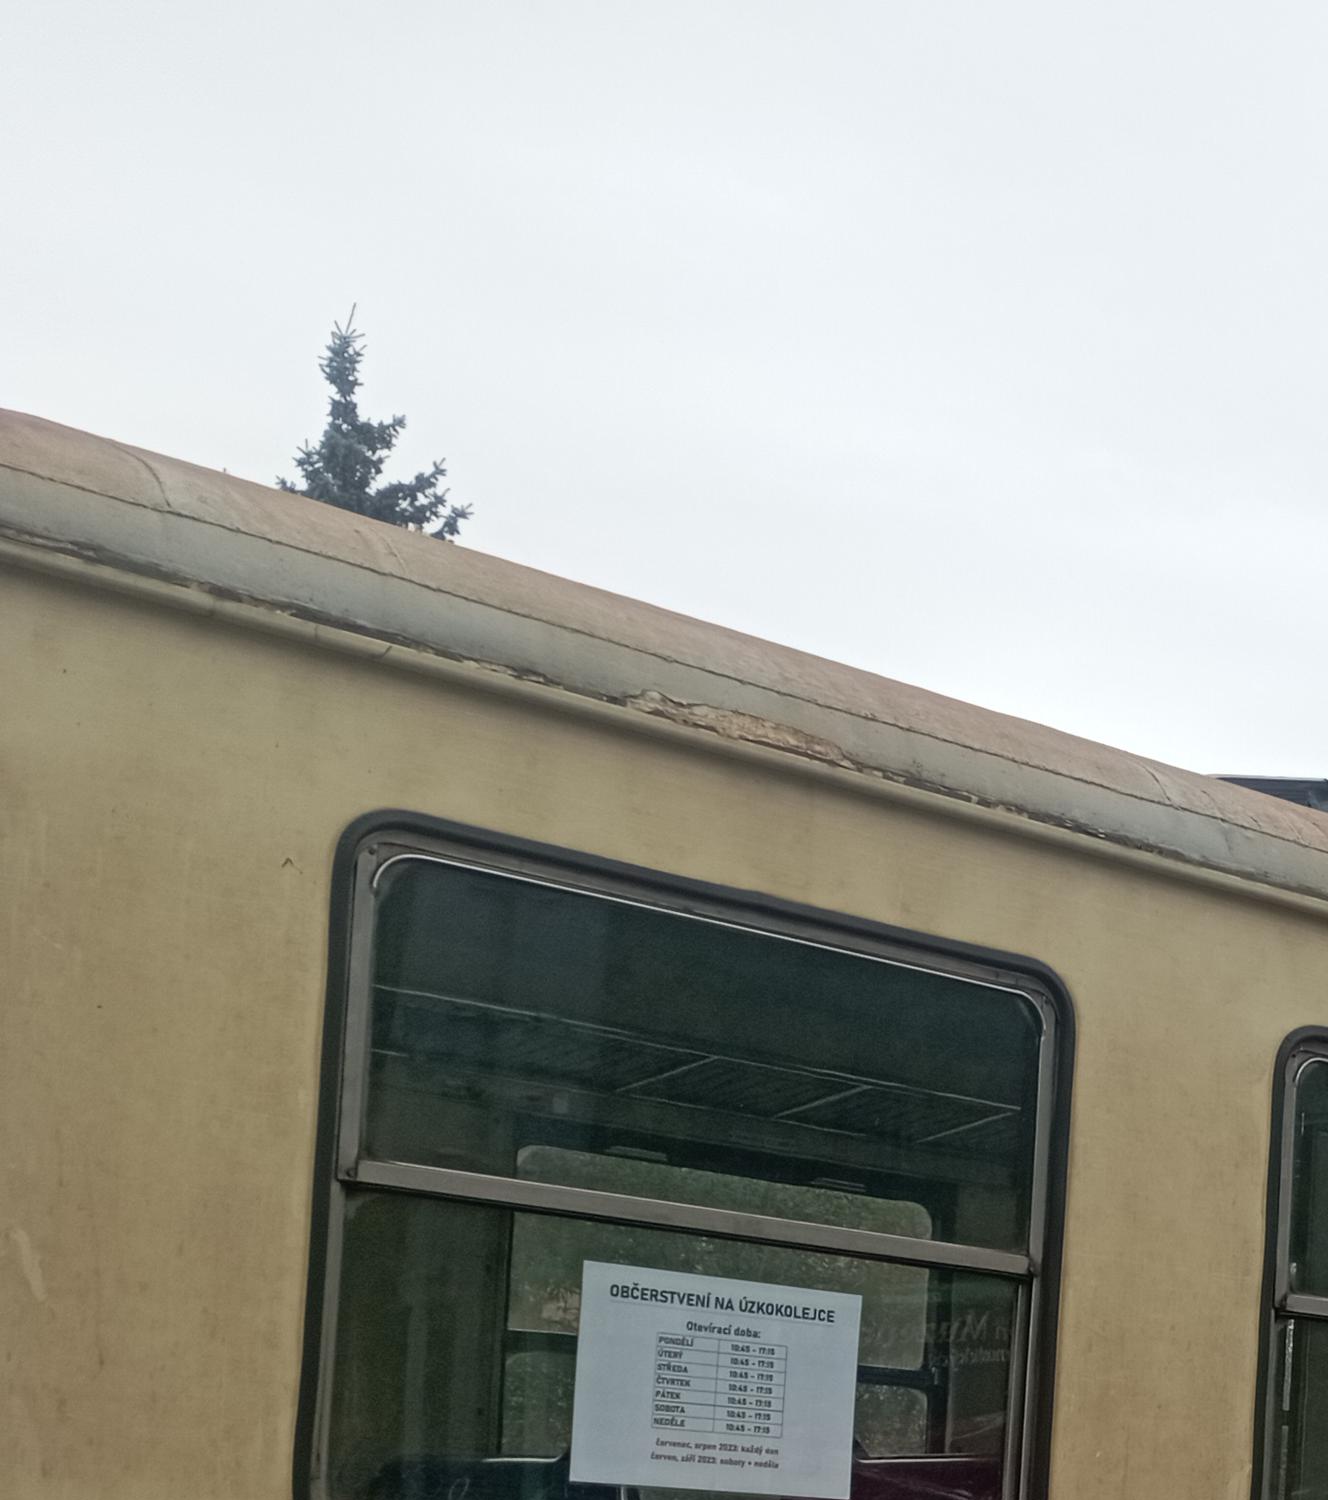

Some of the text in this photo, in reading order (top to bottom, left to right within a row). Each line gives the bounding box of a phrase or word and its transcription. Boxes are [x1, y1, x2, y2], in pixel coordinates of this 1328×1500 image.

[609, 1282, 836, 1323] OBČERSTVENÍ NA ÚZKOKOLEJCE
[685, 1320, 761, 1339] Otevírací doba:
[655, 1388, 681, 1400] PÁTEK
[654, 1403, 685, 1414] SOBOTA
